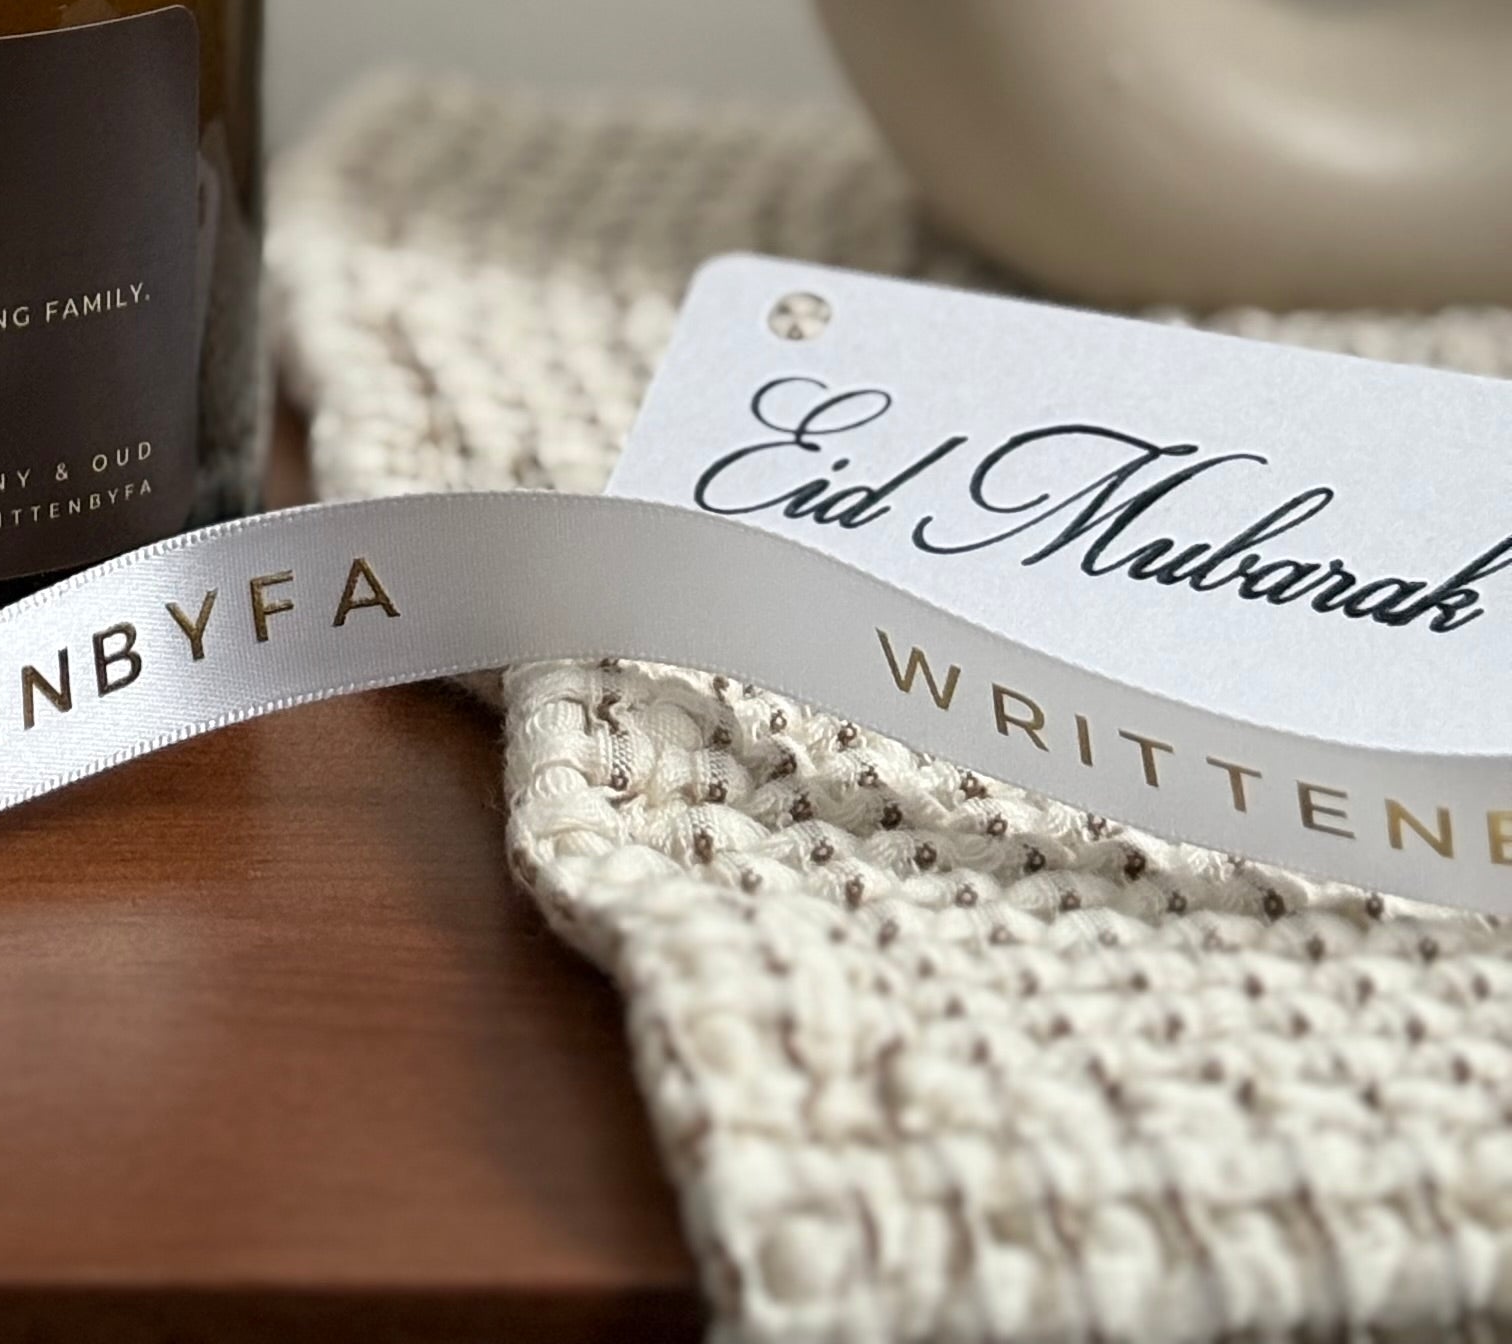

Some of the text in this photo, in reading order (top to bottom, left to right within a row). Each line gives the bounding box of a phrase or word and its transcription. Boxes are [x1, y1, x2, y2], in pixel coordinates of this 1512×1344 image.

[45, 282, 151, 323] FAMILY.
[55, 463, 69, 482] &
[92, 441, 152, 473] OUD
[693, 376, 1512, 633] Eid Mubarak
